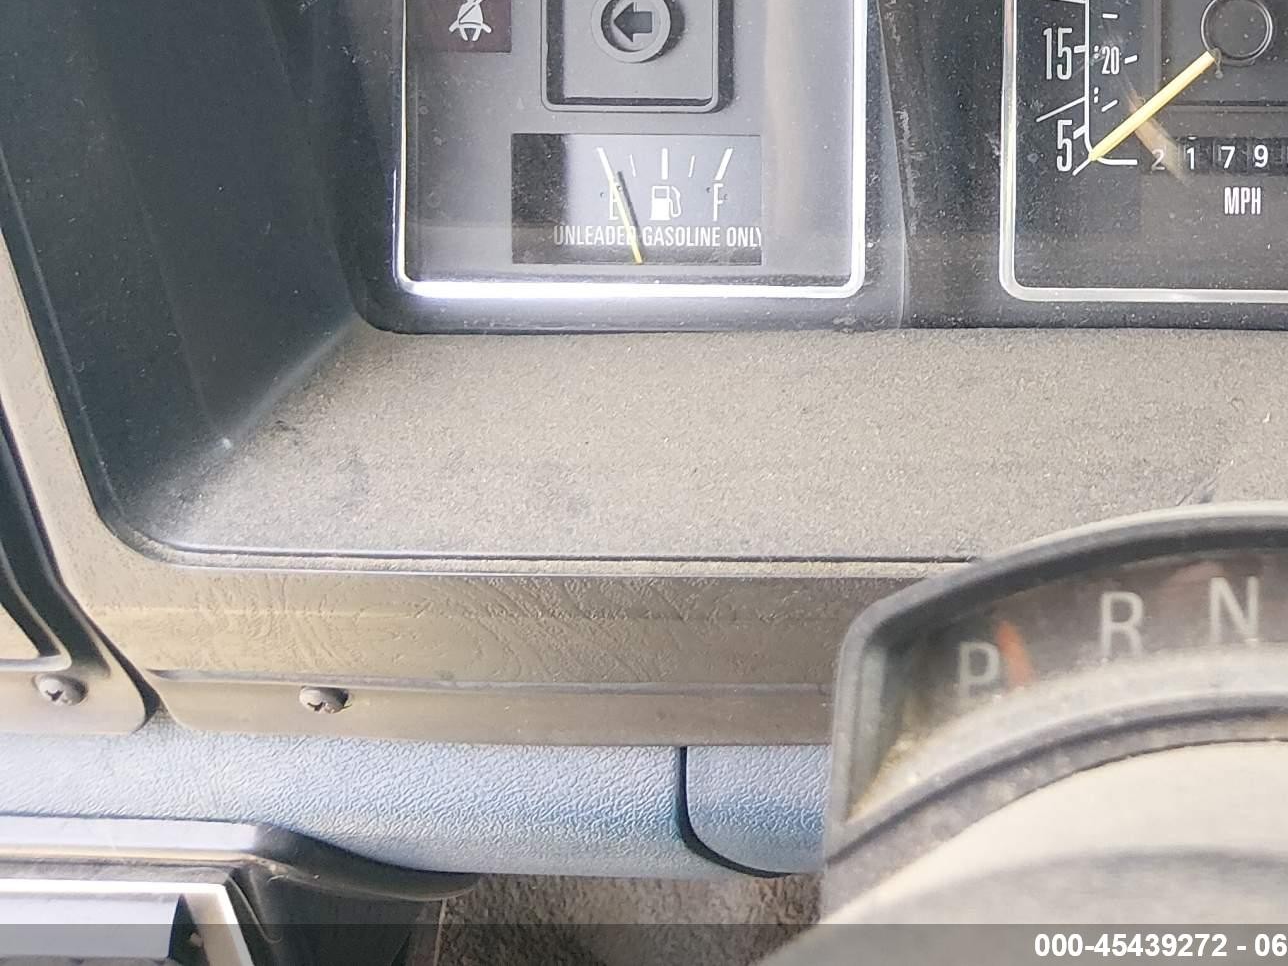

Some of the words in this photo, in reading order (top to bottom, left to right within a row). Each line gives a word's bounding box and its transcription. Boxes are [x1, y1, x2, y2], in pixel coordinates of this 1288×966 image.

[1043, 27, 1073, 80] 15
[1101, 46, 1120, 74] 20
[1056, 119, 1073, 172] 5
[713, 183, 723, 221] F
[1224, 186, 1261, 215] MPH
[642, 226, 721, 247] GASOLINE
[958, 641, 1000, 697] P
[1100, 591, 1144, 661] R
[1209, 576, 1259, 643] N
